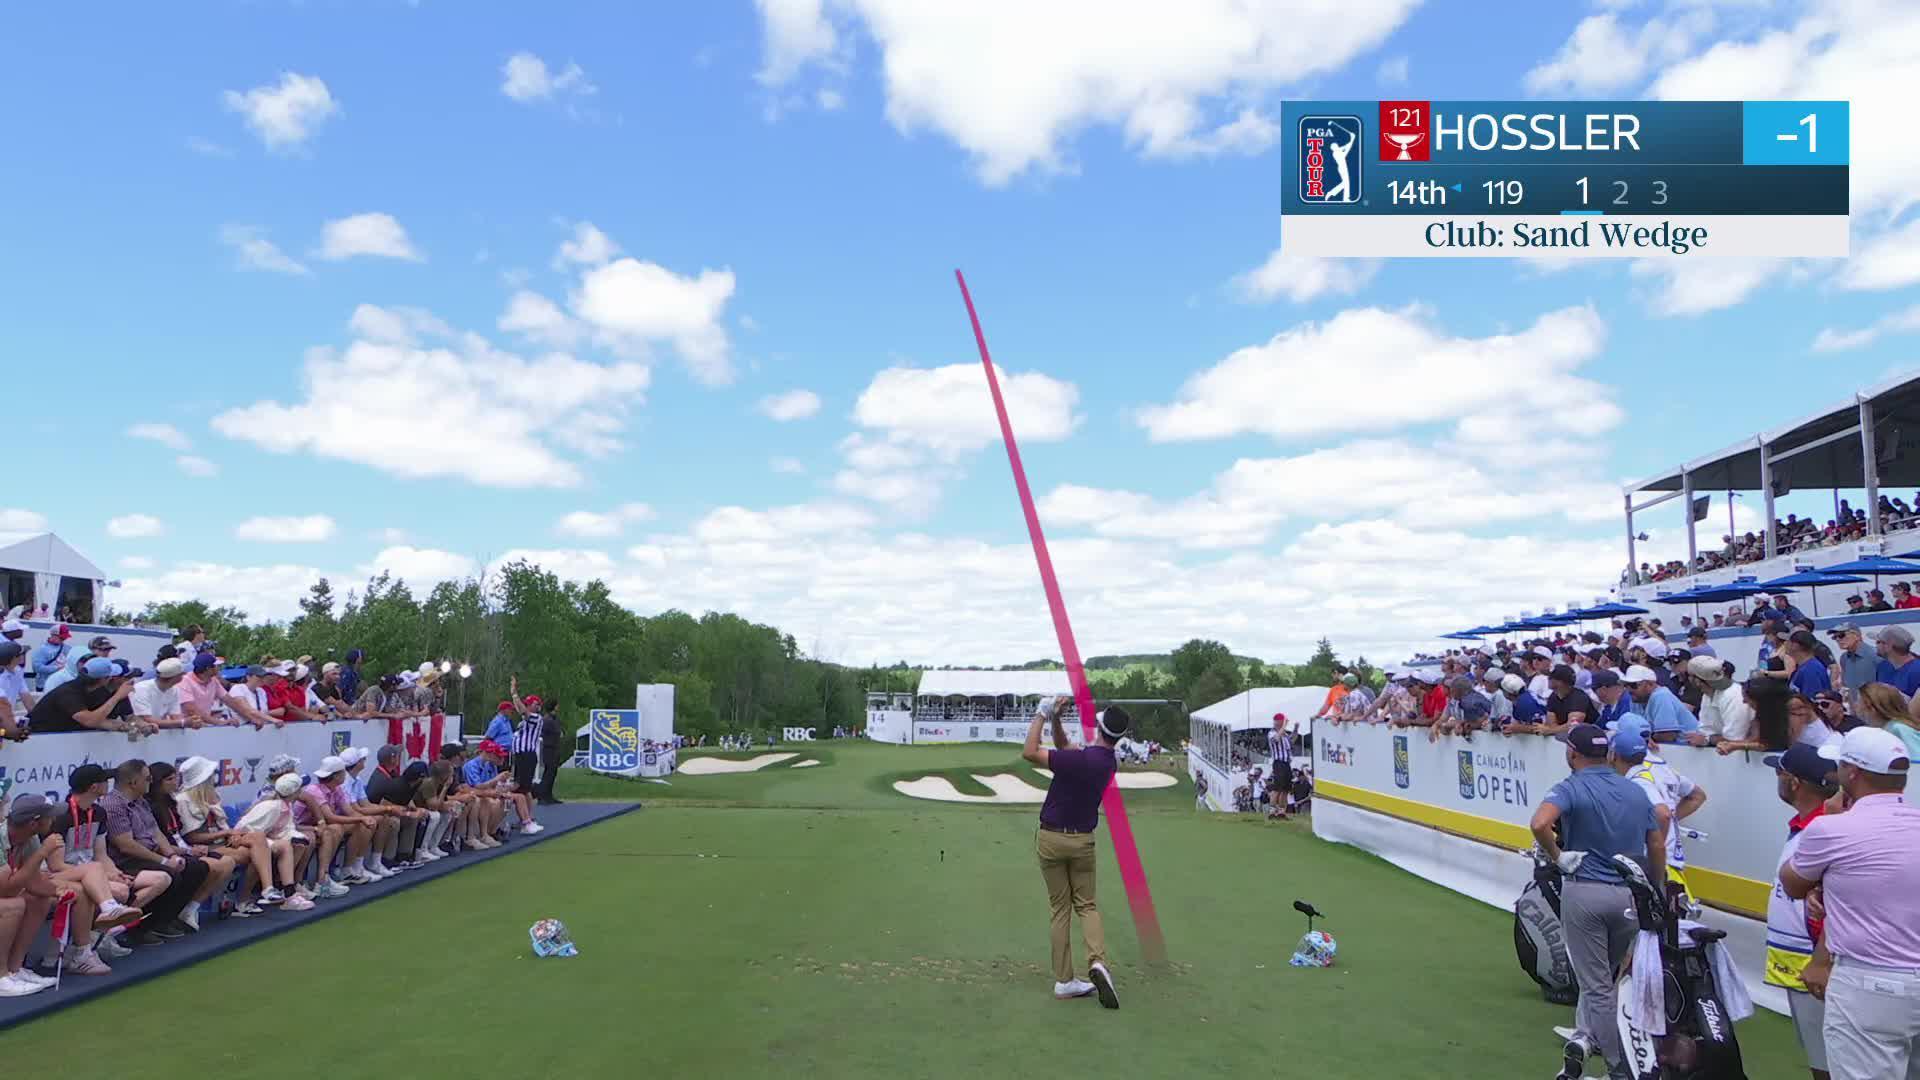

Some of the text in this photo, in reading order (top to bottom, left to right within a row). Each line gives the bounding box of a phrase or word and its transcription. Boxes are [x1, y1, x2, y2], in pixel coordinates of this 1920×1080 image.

[783, 727, 817, 742] RBC
[595, 753, 636, 768] RBC
[1327, 742, 1348, 766] FedEx
[1476, 751, 1527, 774] CANADIAN
[1477, 773, 1529, 807] OPEN
[1697, 997, 1724, 1043] Titleist
